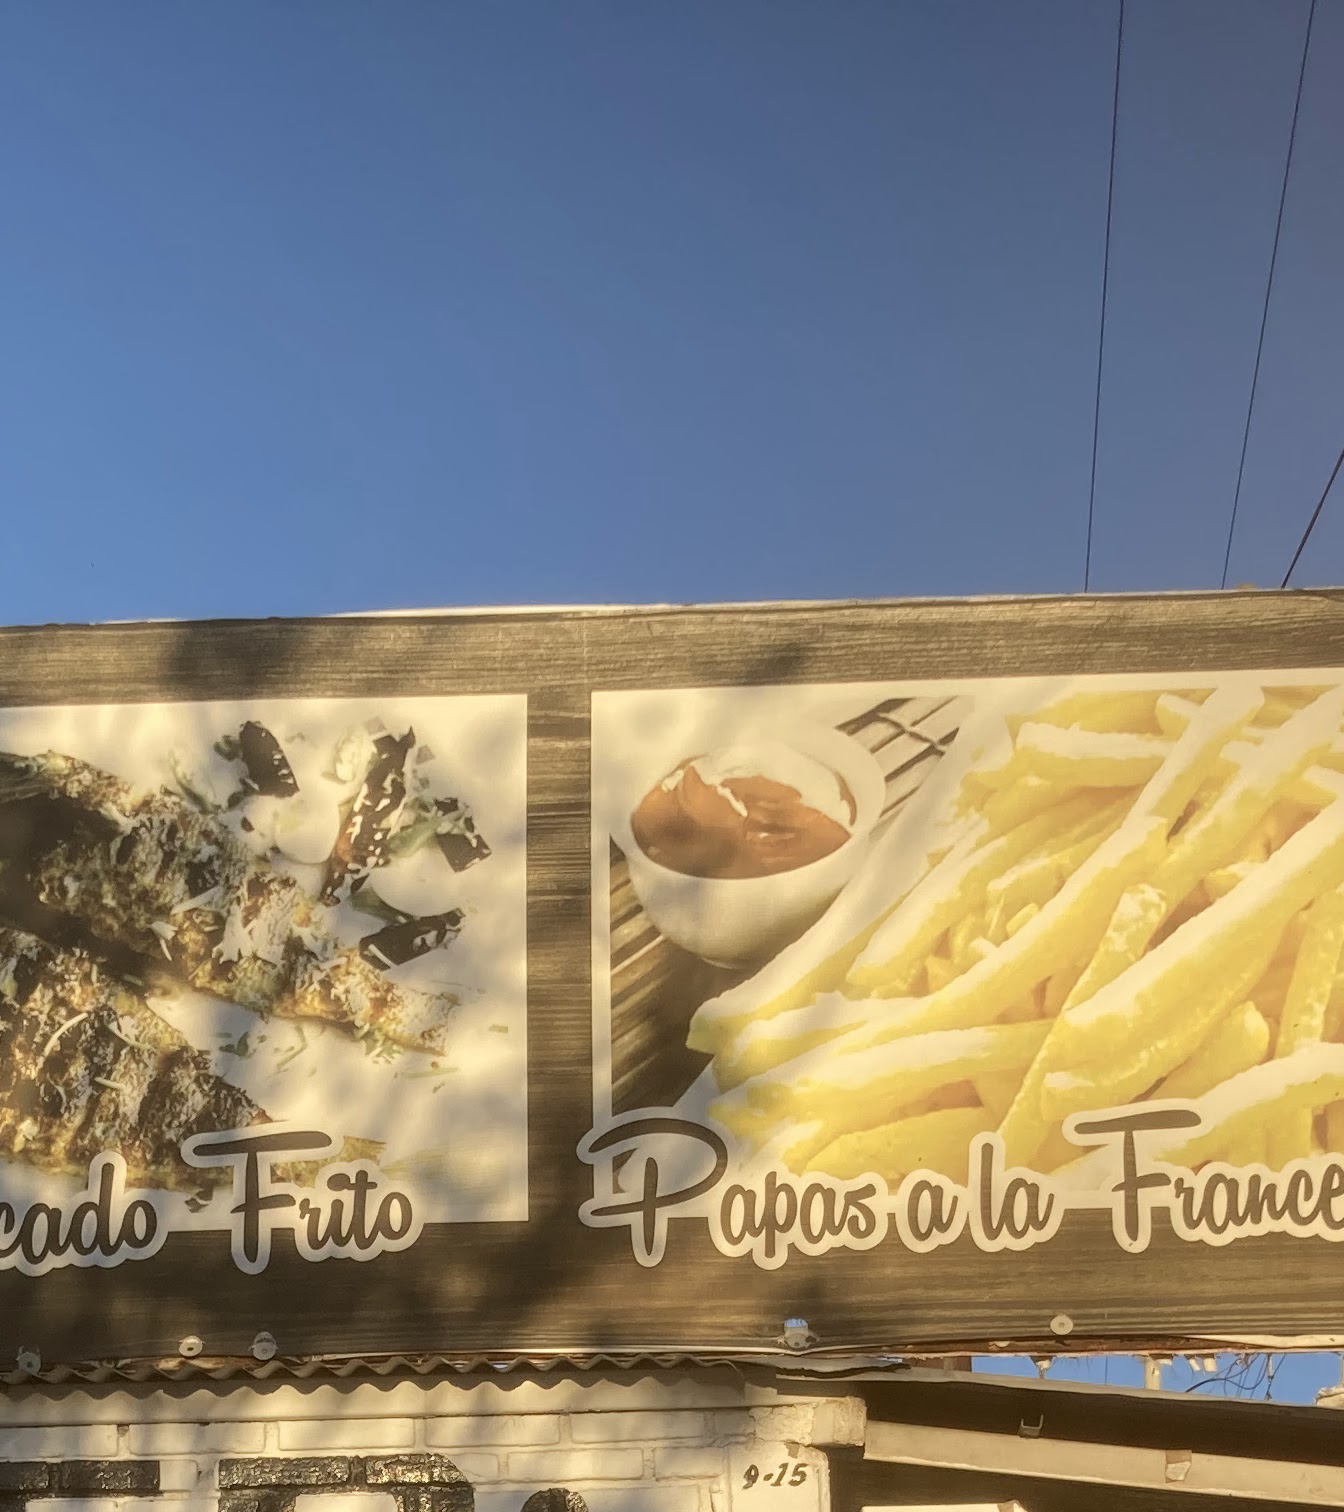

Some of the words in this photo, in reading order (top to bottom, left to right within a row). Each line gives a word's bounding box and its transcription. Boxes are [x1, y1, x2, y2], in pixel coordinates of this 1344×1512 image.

[190, 1130, 416, 1265] Frito
[586, 1117, 879, 1259] Papas
[907, 1186, 959, 1243] a
[979, 1141, 1055, 1242] la
